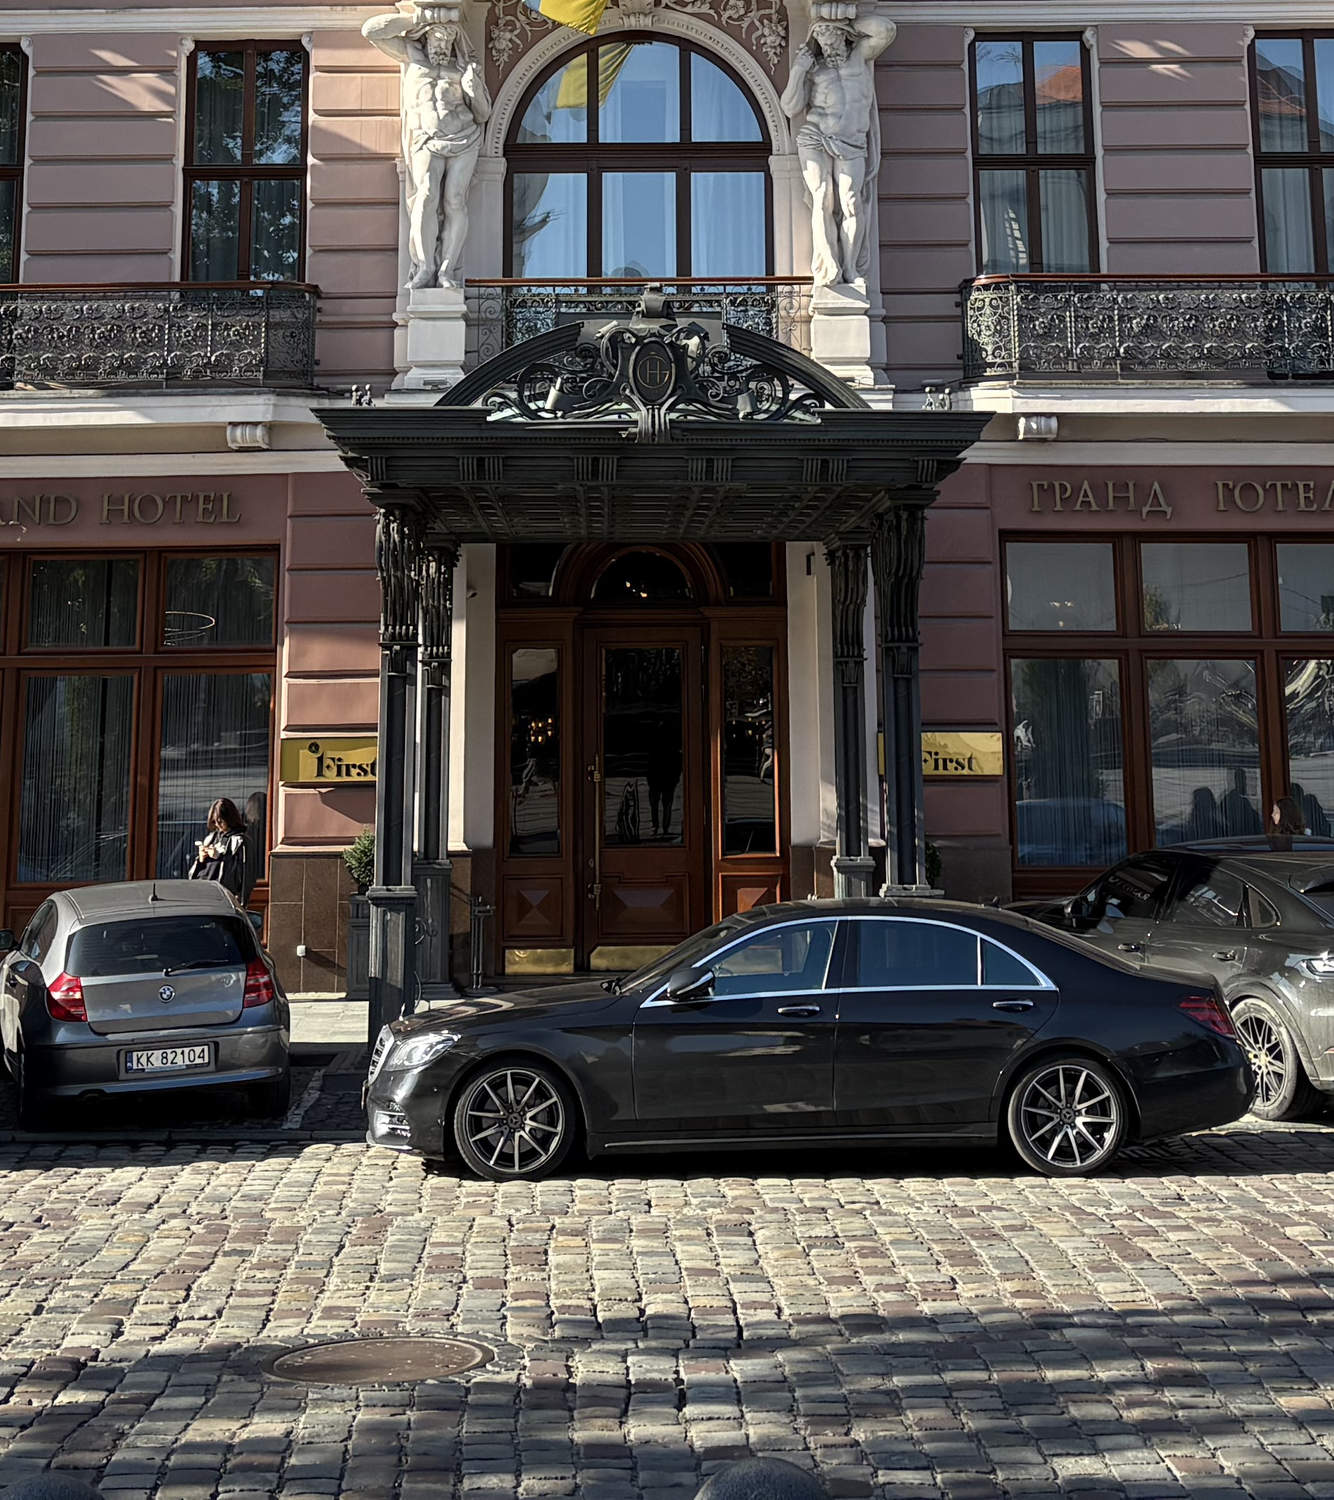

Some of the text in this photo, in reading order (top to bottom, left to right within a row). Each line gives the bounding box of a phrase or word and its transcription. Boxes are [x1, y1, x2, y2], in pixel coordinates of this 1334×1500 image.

[99, 491, 242, 525] HOTEL
[1029, 479, 1173, 520] ГРАНД
[315, 751, 377, 778] First
[135, 1047, 206, 1068] KK 82104
